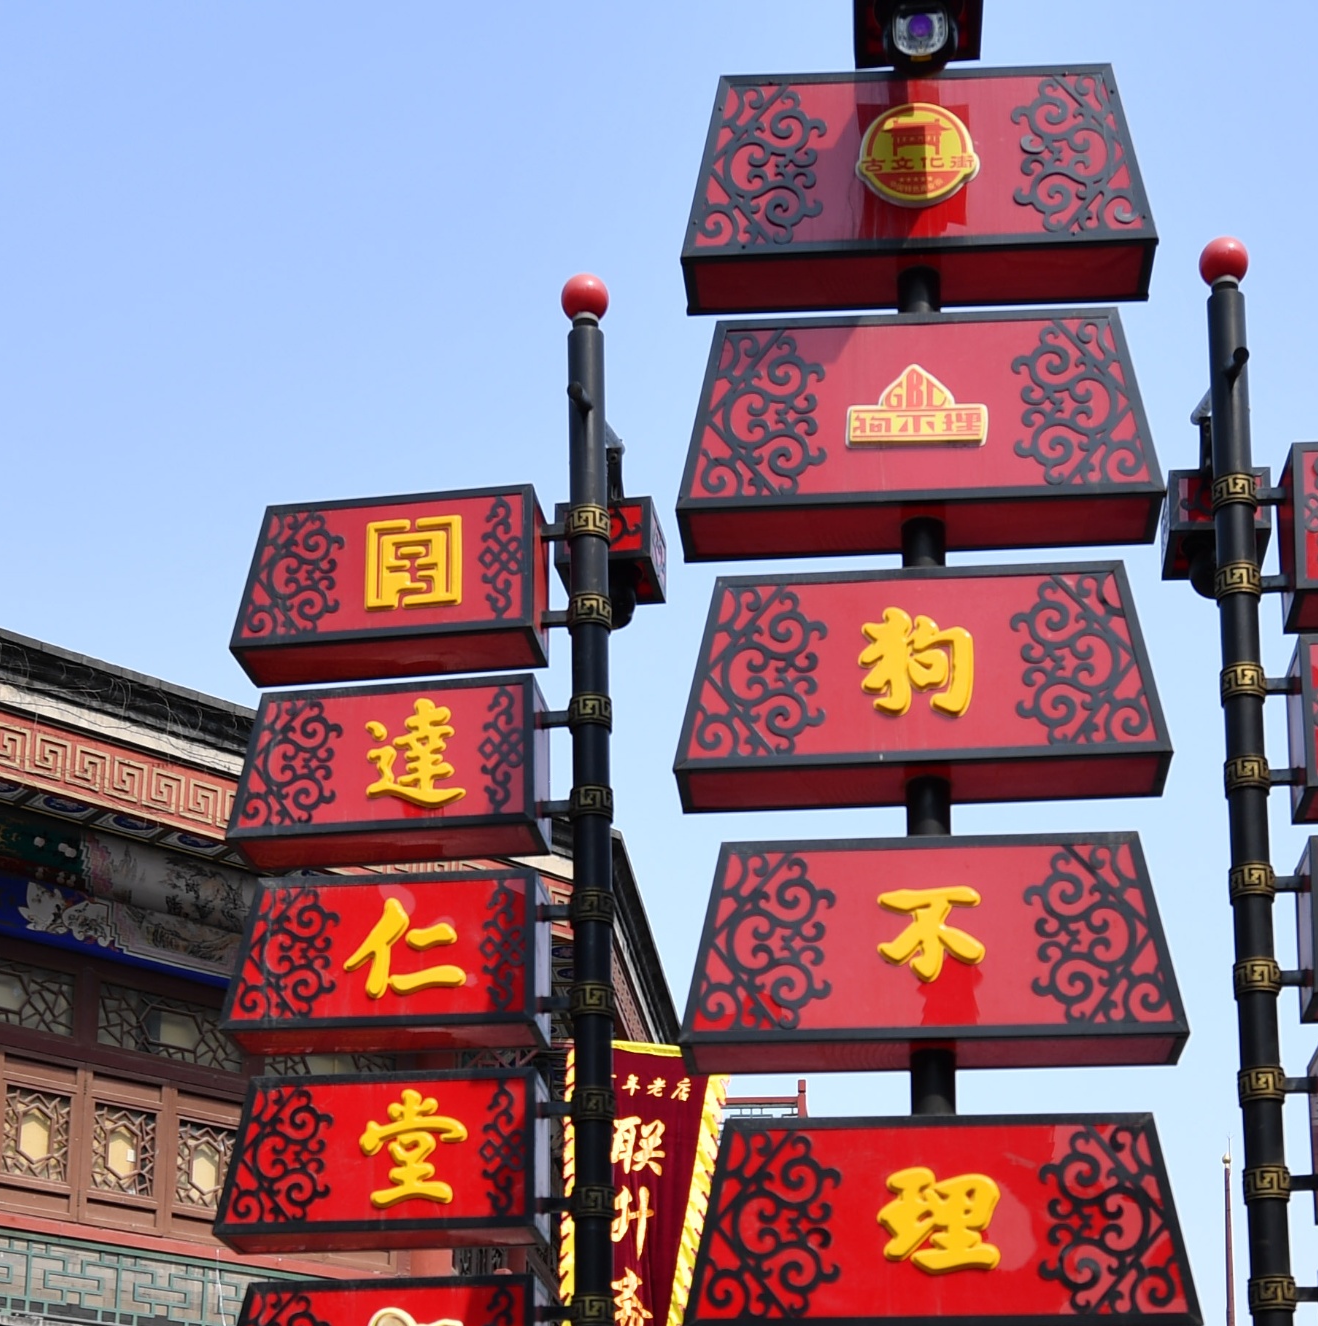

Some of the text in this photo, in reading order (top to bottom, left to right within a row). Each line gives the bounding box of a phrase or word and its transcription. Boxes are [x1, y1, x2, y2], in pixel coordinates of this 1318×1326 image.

[862, 155, 974, 171] 古文化街
[612, 1075, 691, 1101] 年老店
